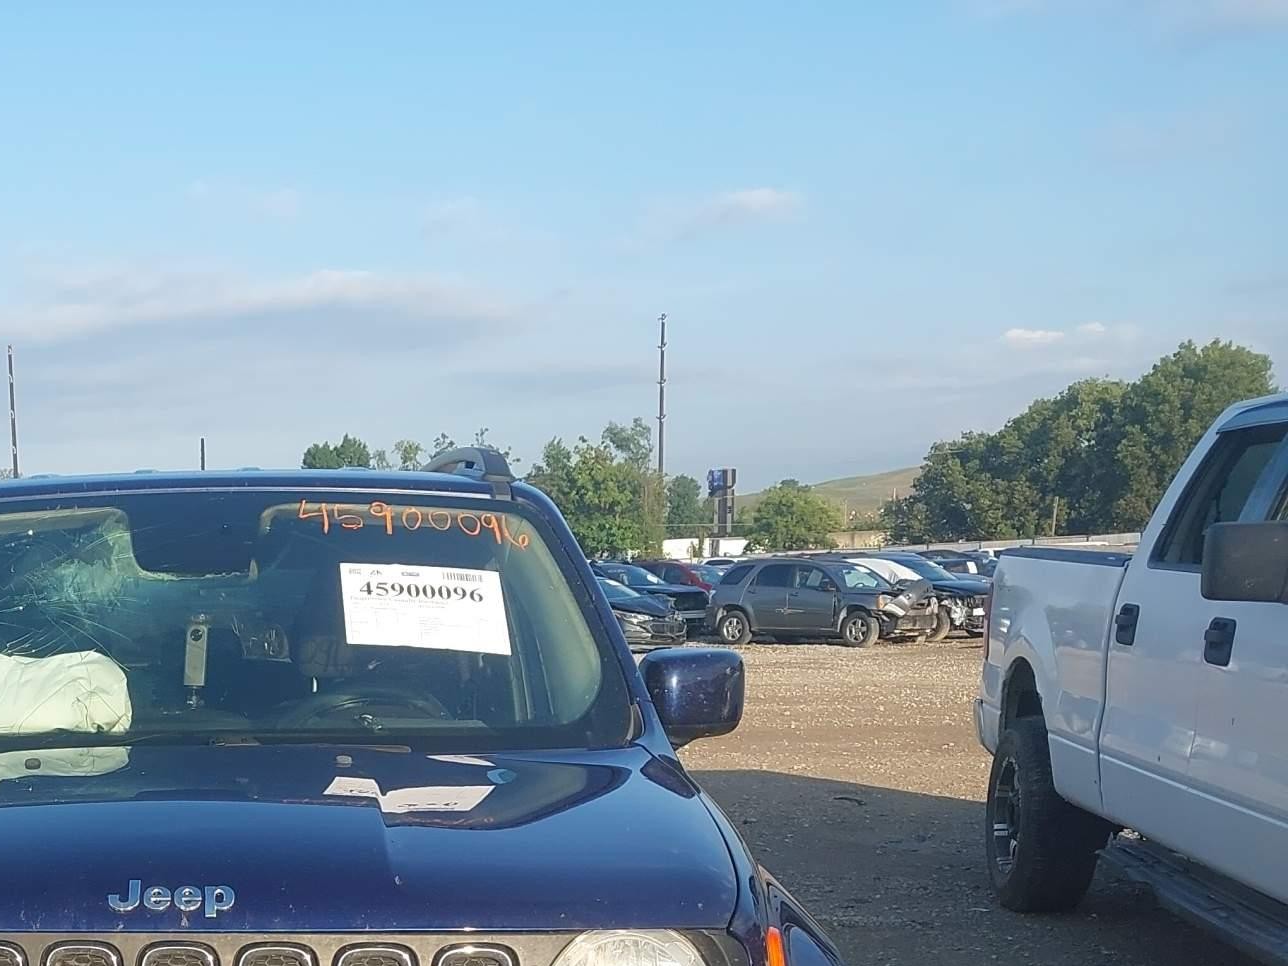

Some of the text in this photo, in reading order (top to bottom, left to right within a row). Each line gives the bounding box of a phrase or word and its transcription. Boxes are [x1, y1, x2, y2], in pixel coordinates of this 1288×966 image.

[298, 500, 530, 551] 45900096
[359, 580, 485, 603] 45900096
[108, 879, 236, 918] Jeep
